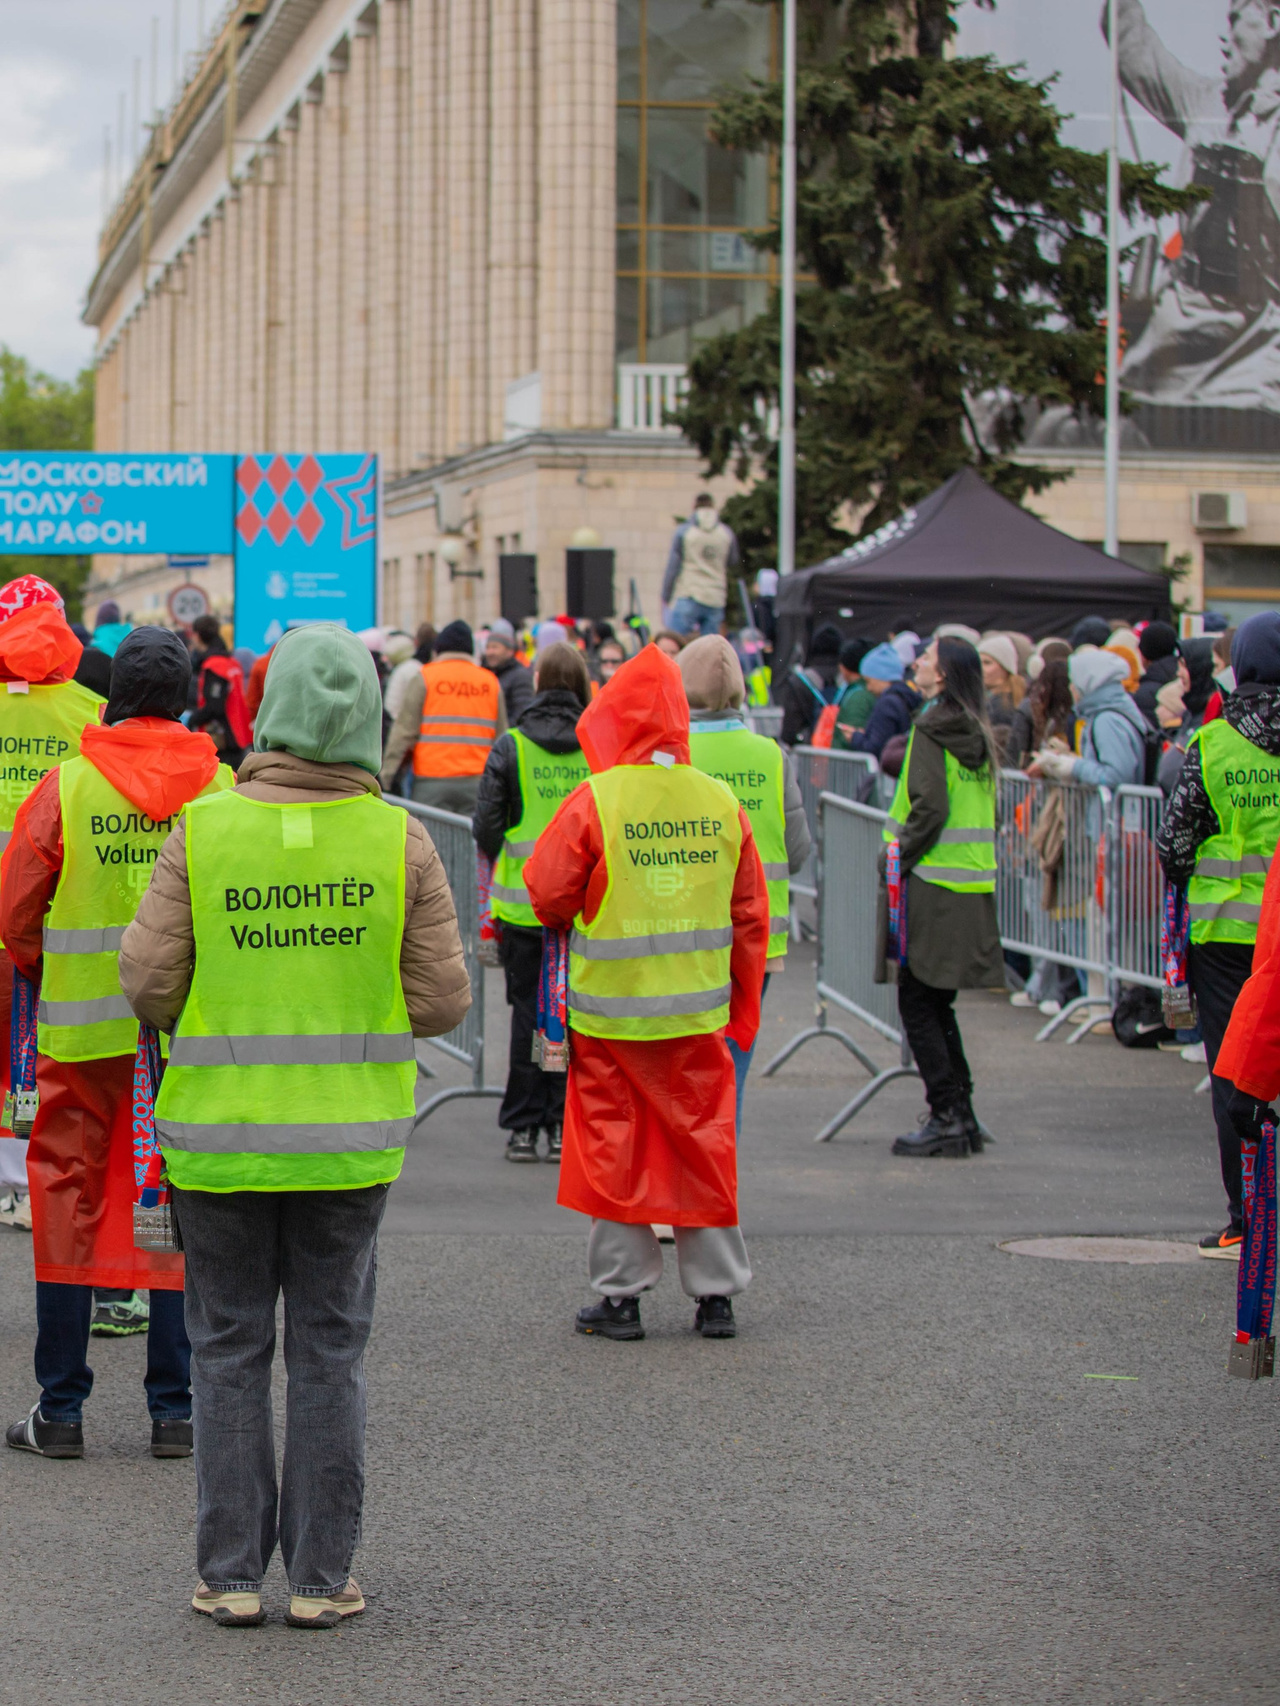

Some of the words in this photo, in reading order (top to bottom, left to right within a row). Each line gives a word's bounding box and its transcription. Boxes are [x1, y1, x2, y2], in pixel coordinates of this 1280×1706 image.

[436, 680, 491, 699] СУДЬЯ
[532, 765, 590, 780] ВОЛОНТ
[1224, 768, 1280, 787] ВОЛОН
[1230, 792, 1280, 809] Volunt
[91, 812, 183, 835] ВОЛОН
[624, 817, 722, 840] ВОЛОНТЁР
[95, 843, 161, 866] Volun
[629, 848, 719, 867] Volunteer
[225, 877, 375, 912] ВОЛОНТЁР
[230, 922, 367, 950] Volunteer
[132, 1072, 150, 1133] 2025
[1246, 1196, 1266, 1290] МОСКОВСКИЙ
[1263, 1209, 1277, 1289] MARATHON
[1261, 1292, 1274, 1328] HALF
